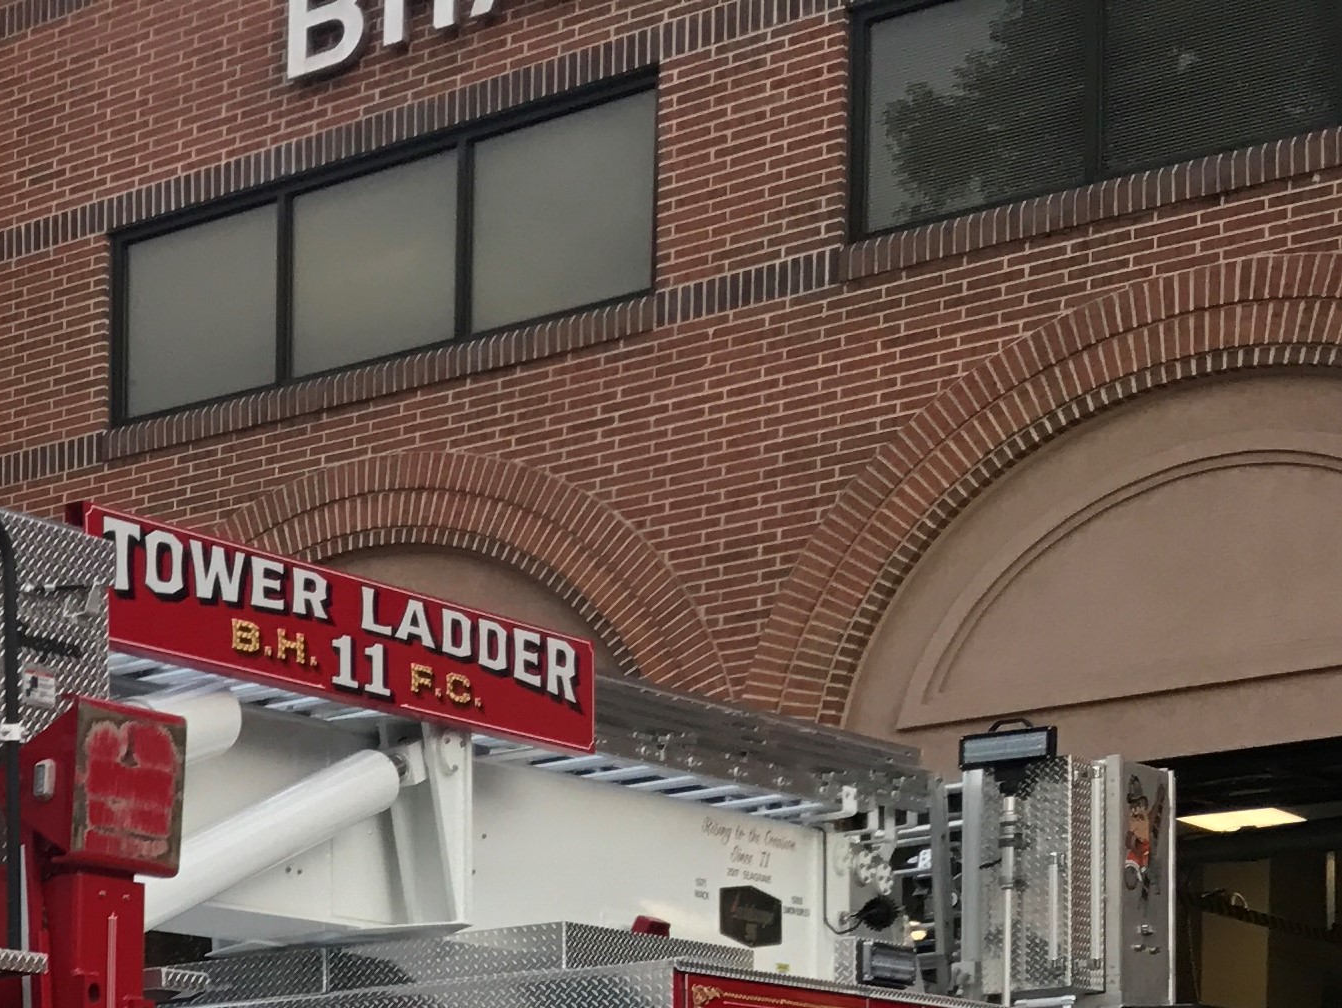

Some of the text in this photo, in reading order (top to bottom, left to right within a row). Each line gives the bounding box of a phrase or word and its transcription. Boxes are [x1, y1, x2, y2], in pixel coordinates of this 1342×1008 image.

[103, 516, 576, 703] TOWER LADDER
[231, 618, 481, 707] B.H. 11 F.C.
